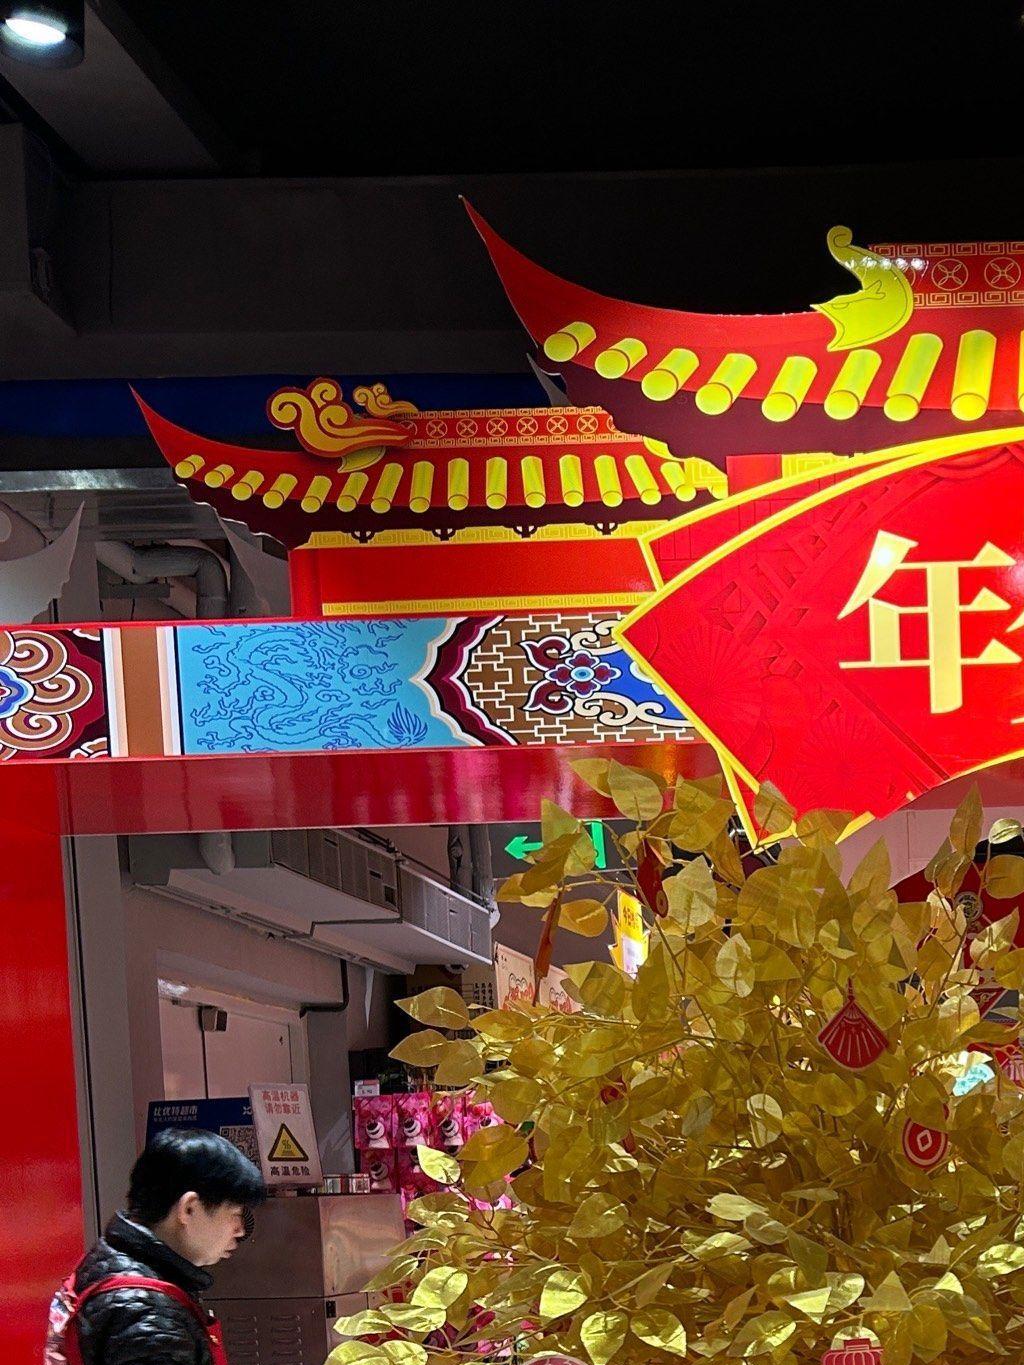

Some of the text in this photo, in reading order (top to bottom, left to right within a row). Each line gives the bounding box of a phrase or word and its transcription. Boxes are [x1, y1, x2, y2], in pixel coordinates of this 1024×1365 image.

[262, 1090, 300, 1101] 高温机器
[154, 1106, 198, 1117] 比优特超市
[265, 1103, 300, 1115] 请勿靠近
[270, 1165, 310, 1177] 高温危险
